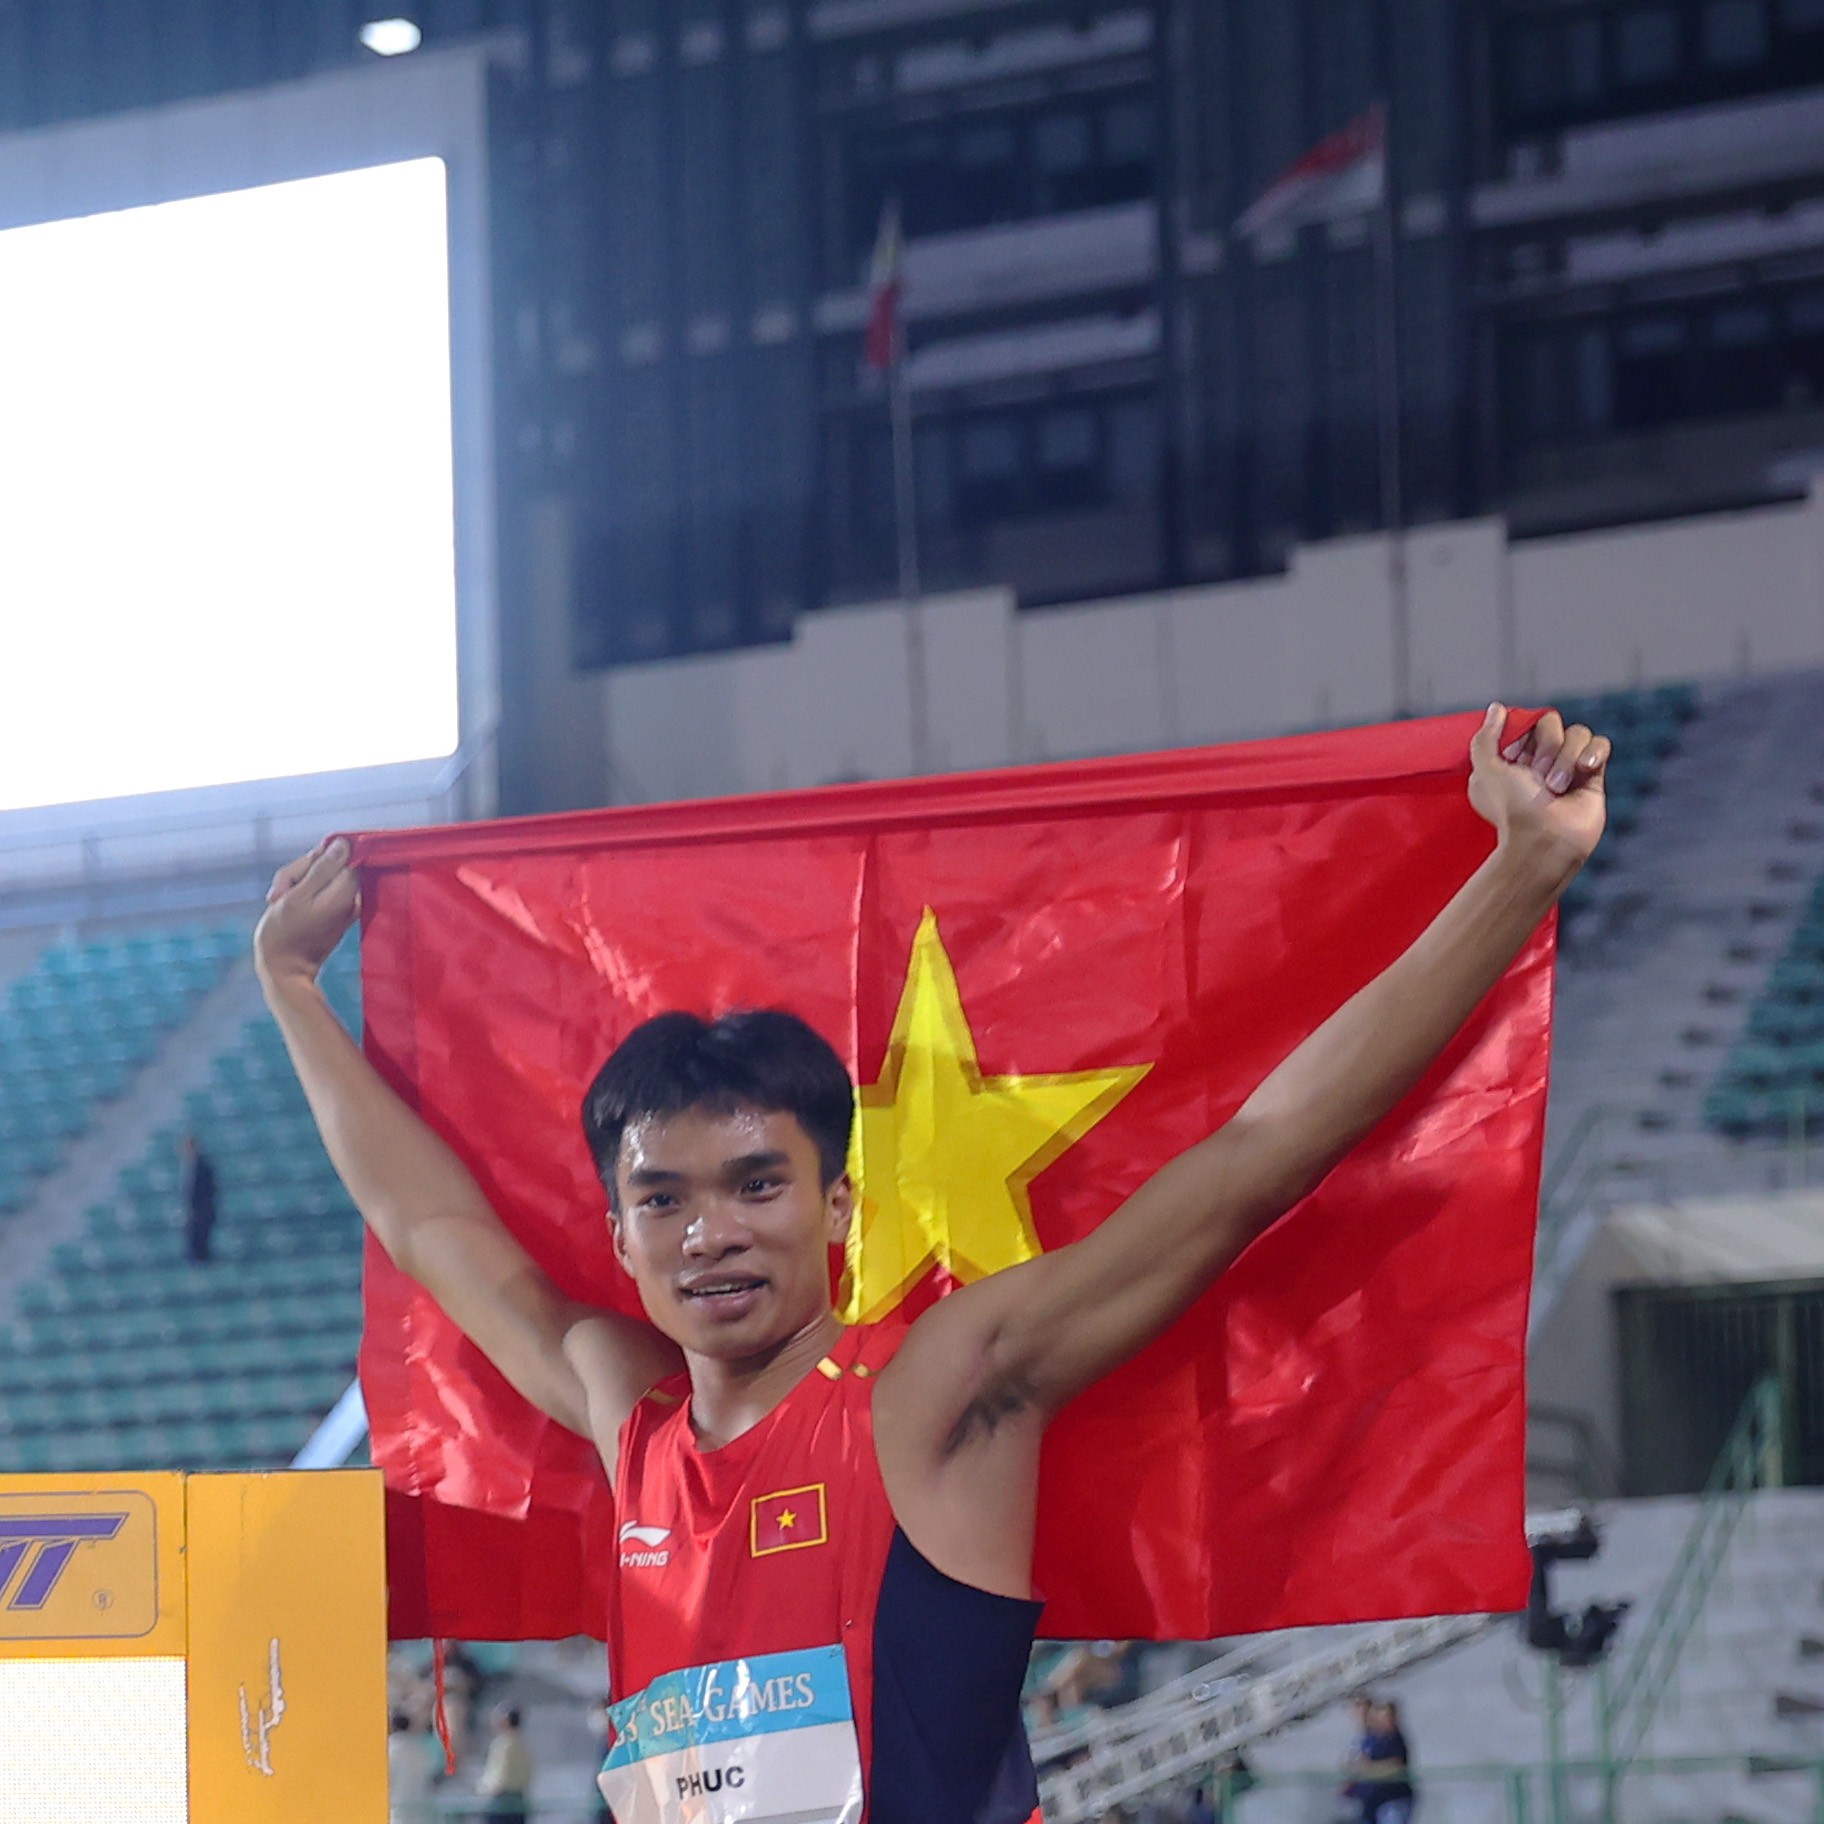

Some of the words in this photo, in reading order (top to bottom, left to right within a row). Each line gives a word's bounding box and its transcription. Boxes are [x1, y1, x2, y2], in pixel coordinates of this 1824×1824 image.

[650, 1693, 697, 1736] SEA
[702, 1671, 814, 1723] GAMES
[676, 1765, 746, 1800] PHUC
